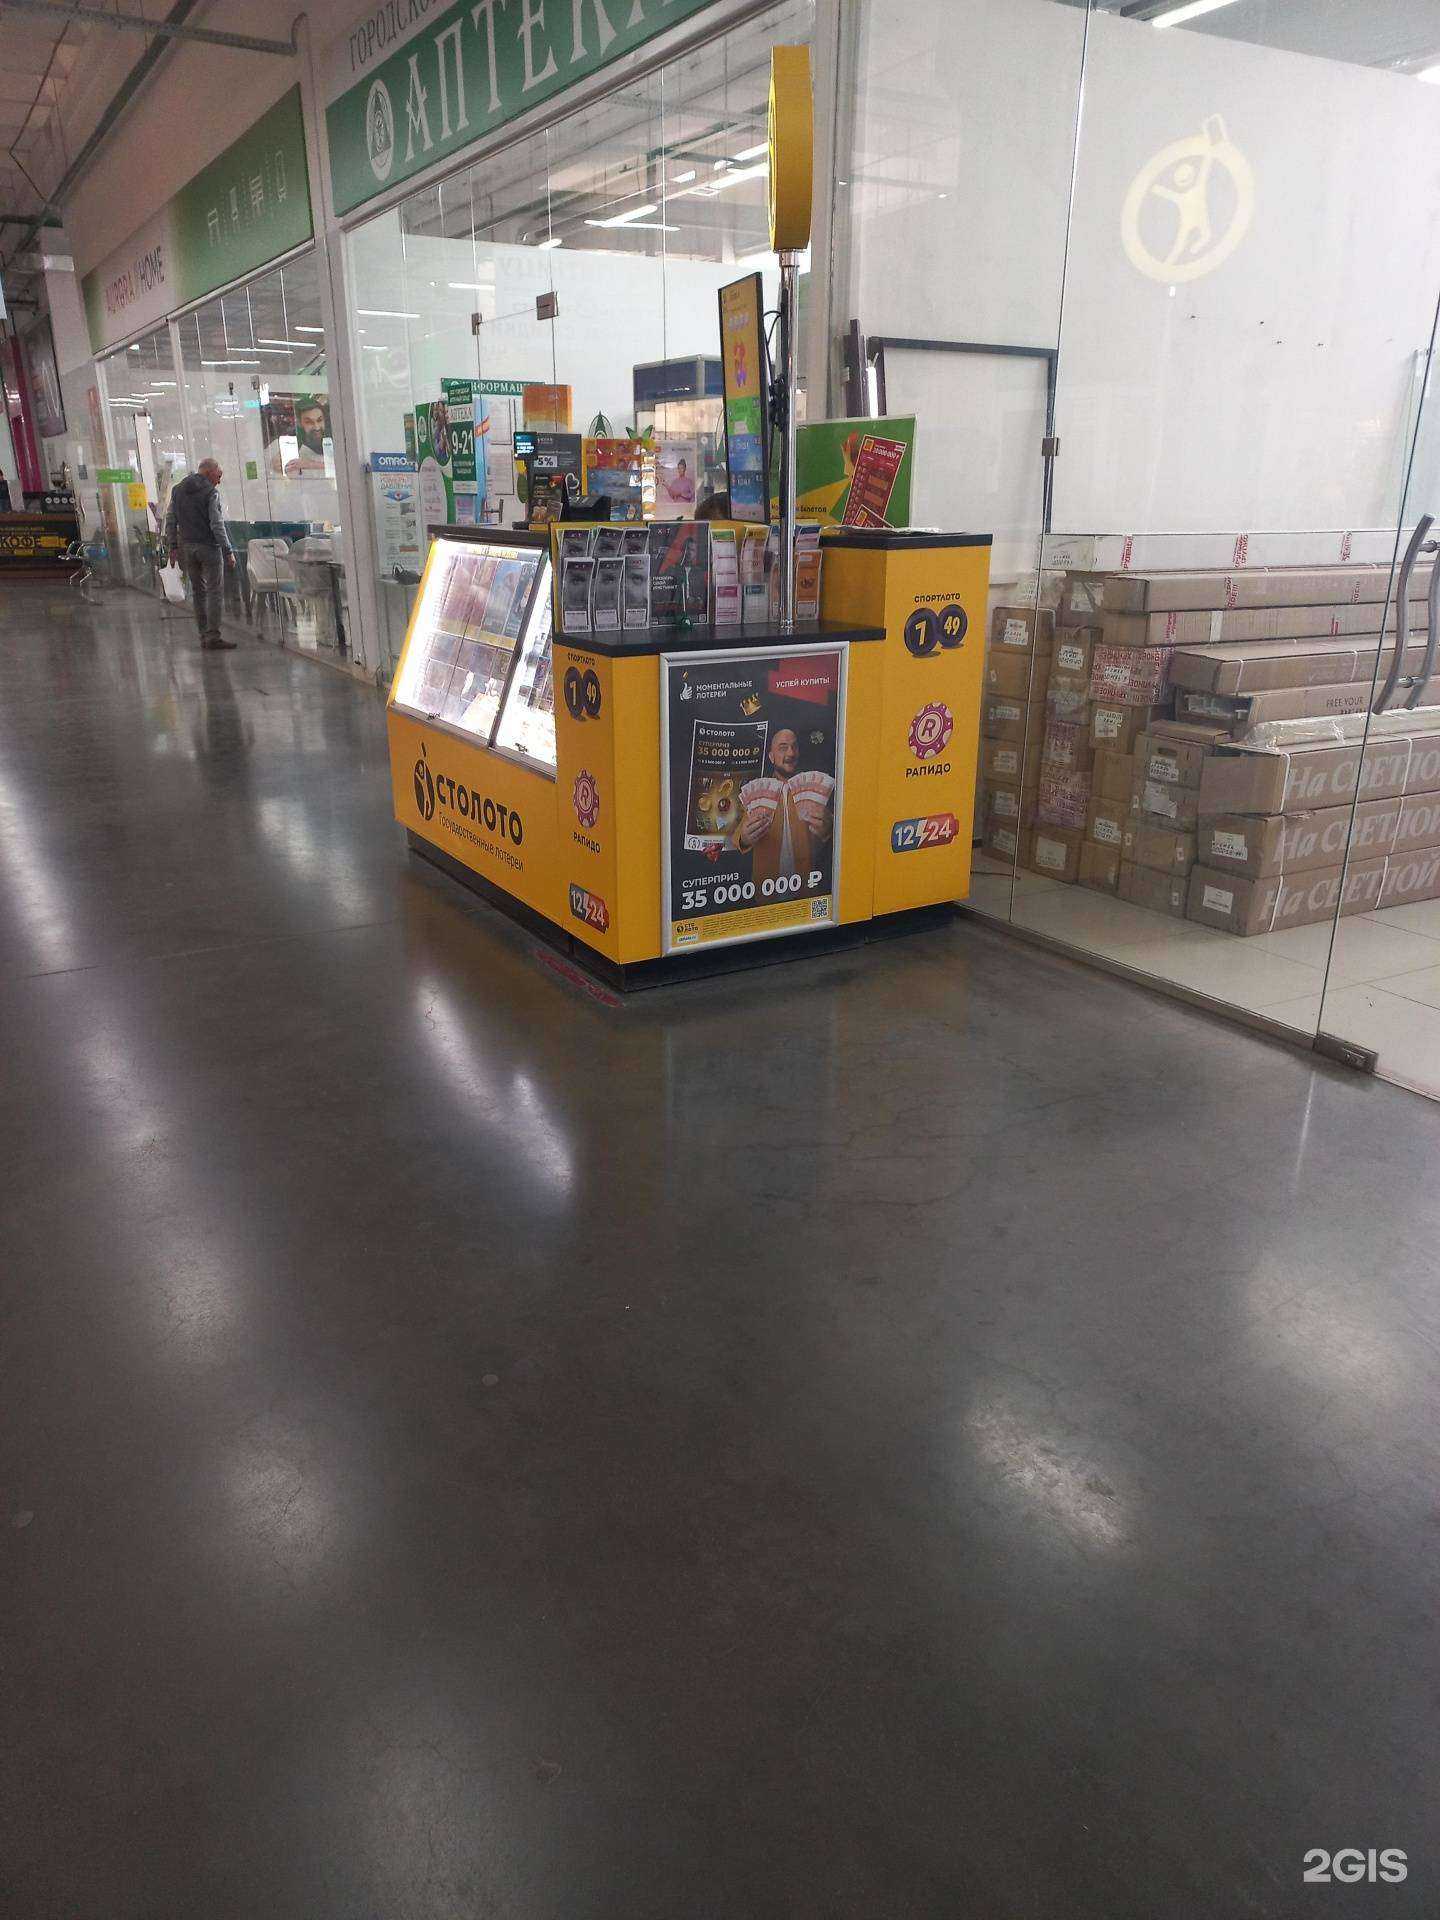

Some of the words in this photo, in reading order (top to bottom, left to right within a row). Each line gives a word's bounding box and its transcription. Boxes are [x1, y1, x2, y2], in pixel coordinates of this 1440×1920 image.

[350, 0, 436, 71] ГОРОДСК
[404, 0, 682, 163] АПТЕ
[463, 382, 523, 393] НФОРМАЦ
[378, 456, 414, 466] OMRO
[914, 592, 961, 603] СПОРТЛОТО
[914, 620, 927, 647] 7
[943, 615, 961, 637] 49
[696, 680, 753, 692] МОМЕНТАЛЬНЫЕ
[776, 679, 800, 689] УСПЕЙ
[696, 690, 727, 700] ЛОТЕРЕИ
[705, 729, 736, 738] СТОЛОТО
[920, 718, 936, 738] R
[711, 748, 730, 757] 000
[732, 748, 751, 757] 000
[905, 763, 951, 778] РАПИДО
[1286, 766, 1327, 801] На
[435, 774, 524, 846] СТОЛОТО
[572, 831, 601, 854] РАПИДО
[1272, 831, 1317, 864] На
[682, 872, 740, 889] СУПЕРПРИЗ
[681, 890, 707, 910] 35
[713, 881, 756, 904] 000
[761, 874, 802, 896] 000
